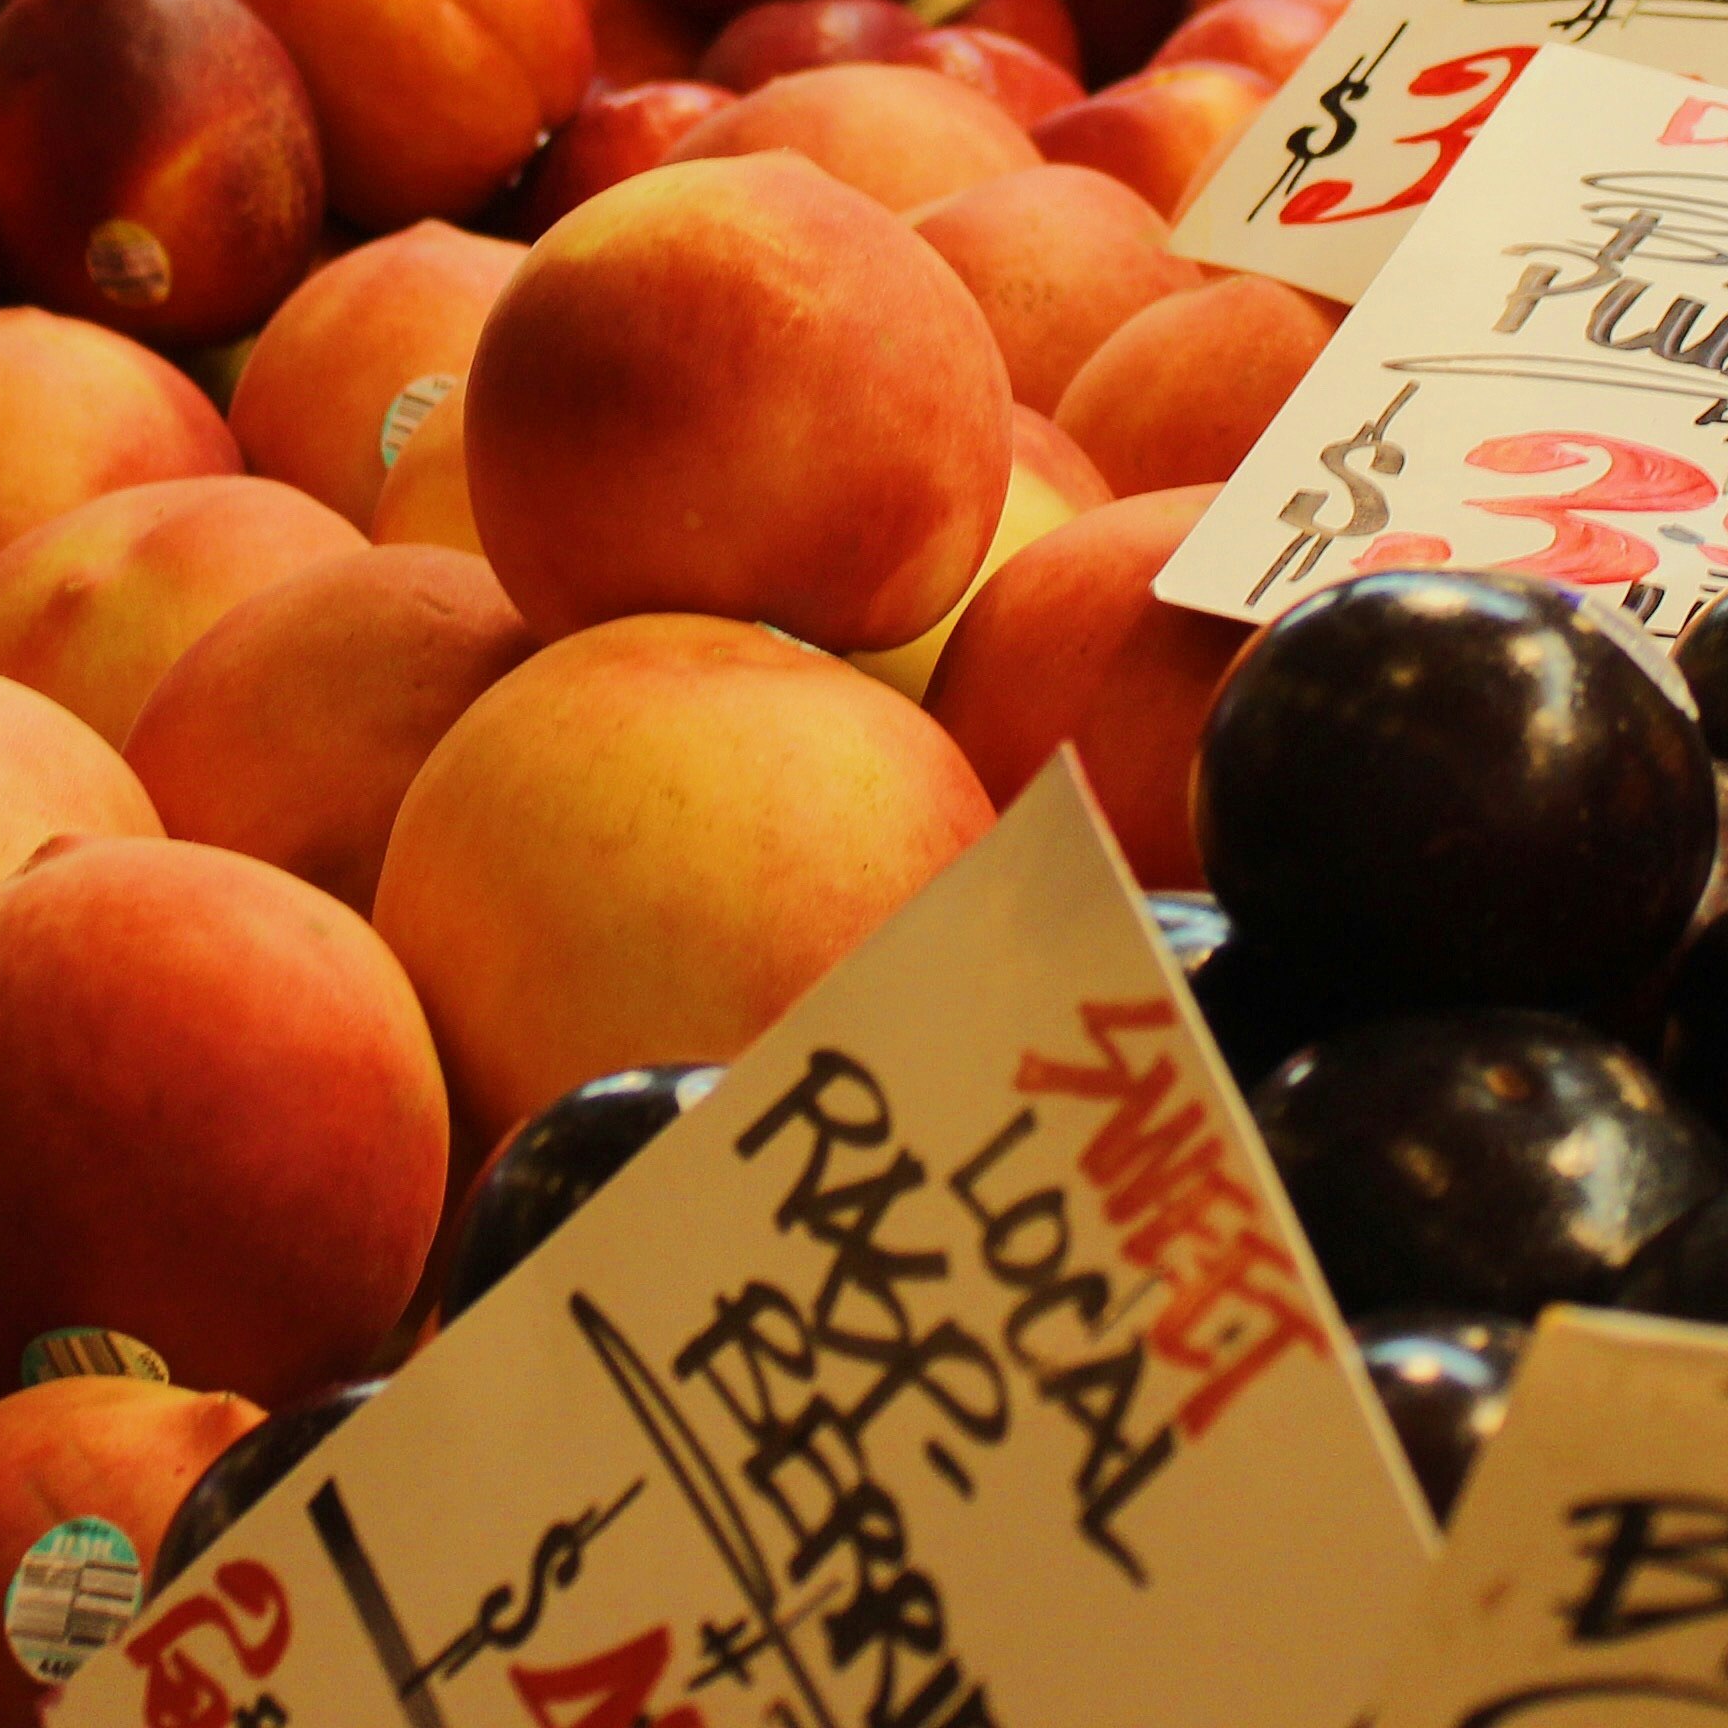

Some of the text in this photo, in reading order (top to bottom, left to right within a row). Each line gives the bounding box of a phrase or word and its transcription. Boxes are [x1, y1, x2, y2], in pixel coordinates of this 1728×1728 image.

[732, 1046, 1014, 1500] RASP-
[948, 1106, 1180, 1592] LOCAL
[1014, 997, 1332, 1442] SWEET
